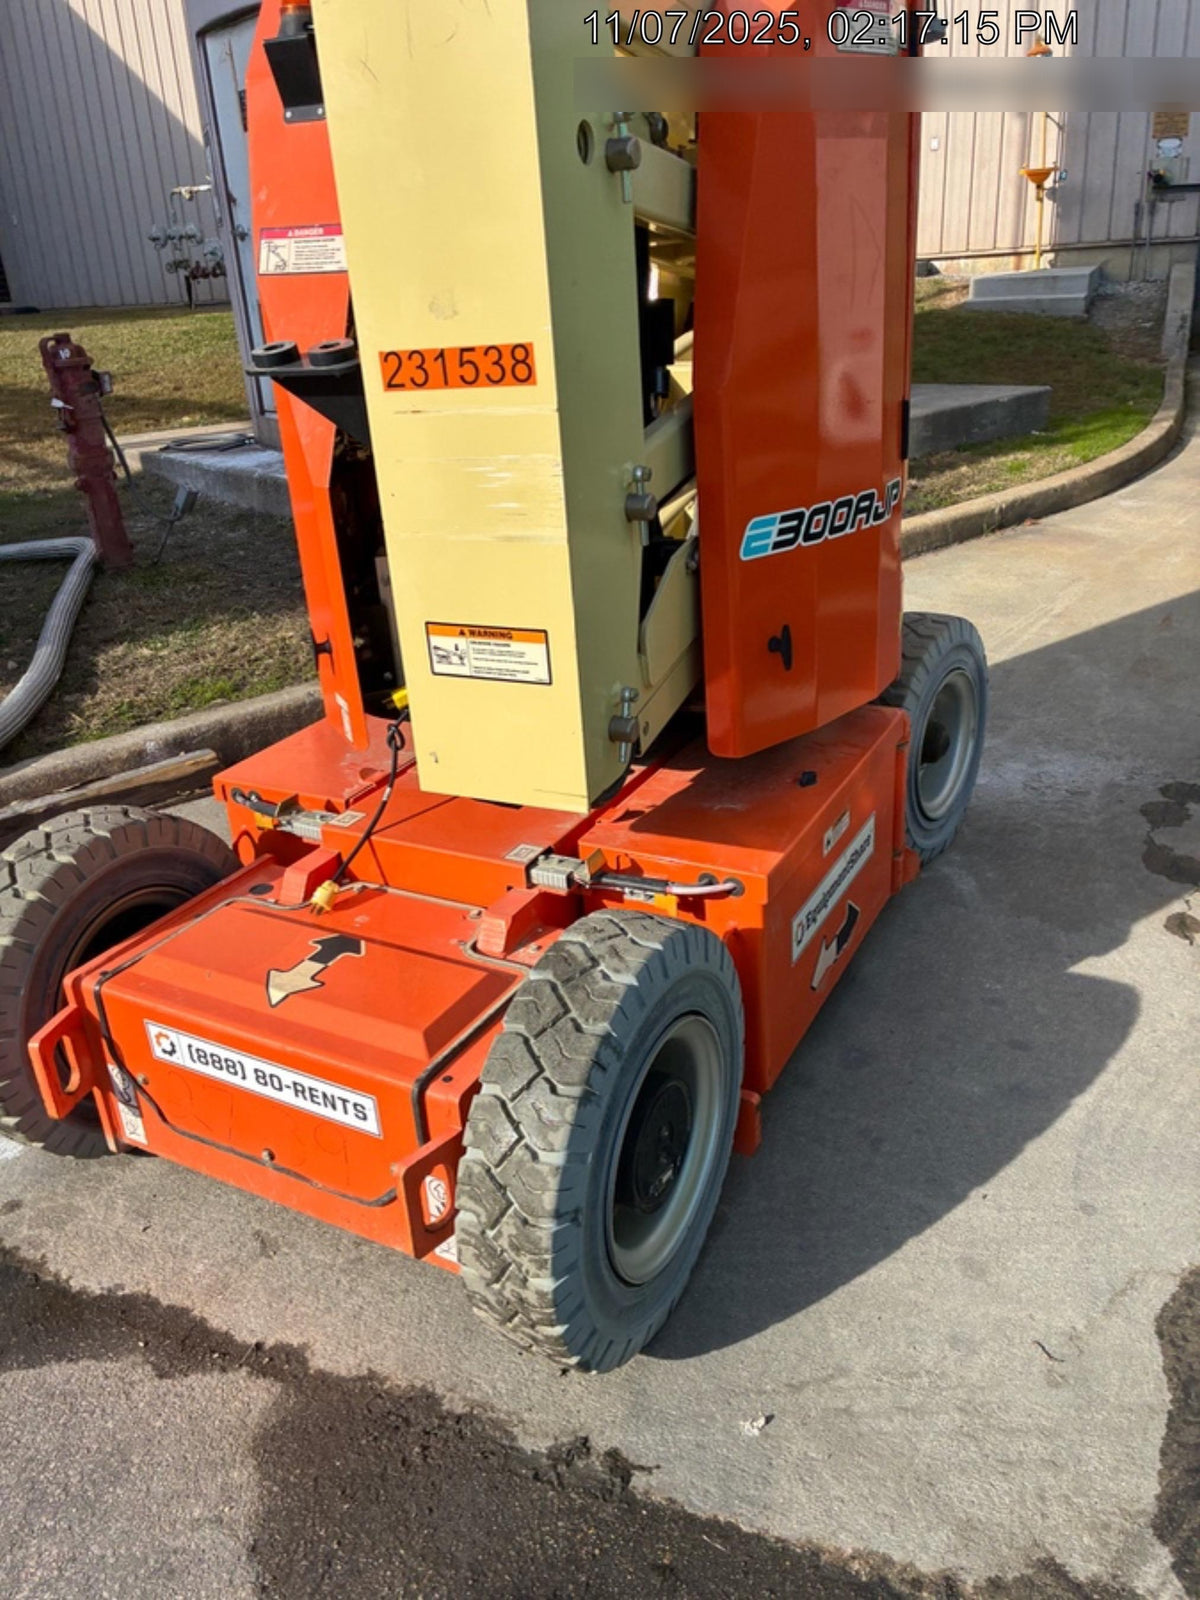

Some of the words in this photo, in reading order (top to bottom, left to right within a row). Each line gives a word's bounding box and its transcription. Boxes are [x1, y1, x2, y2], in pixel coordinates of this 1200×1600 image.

[383, 343, 533, 389] 231538
[739, 477, 901, 561] E300AJP
[468, 628, 514, 640] WARNING
[187, 1043, 247, 1081] (888)
[253, 1067, 369, 1123] 80-RENTS
